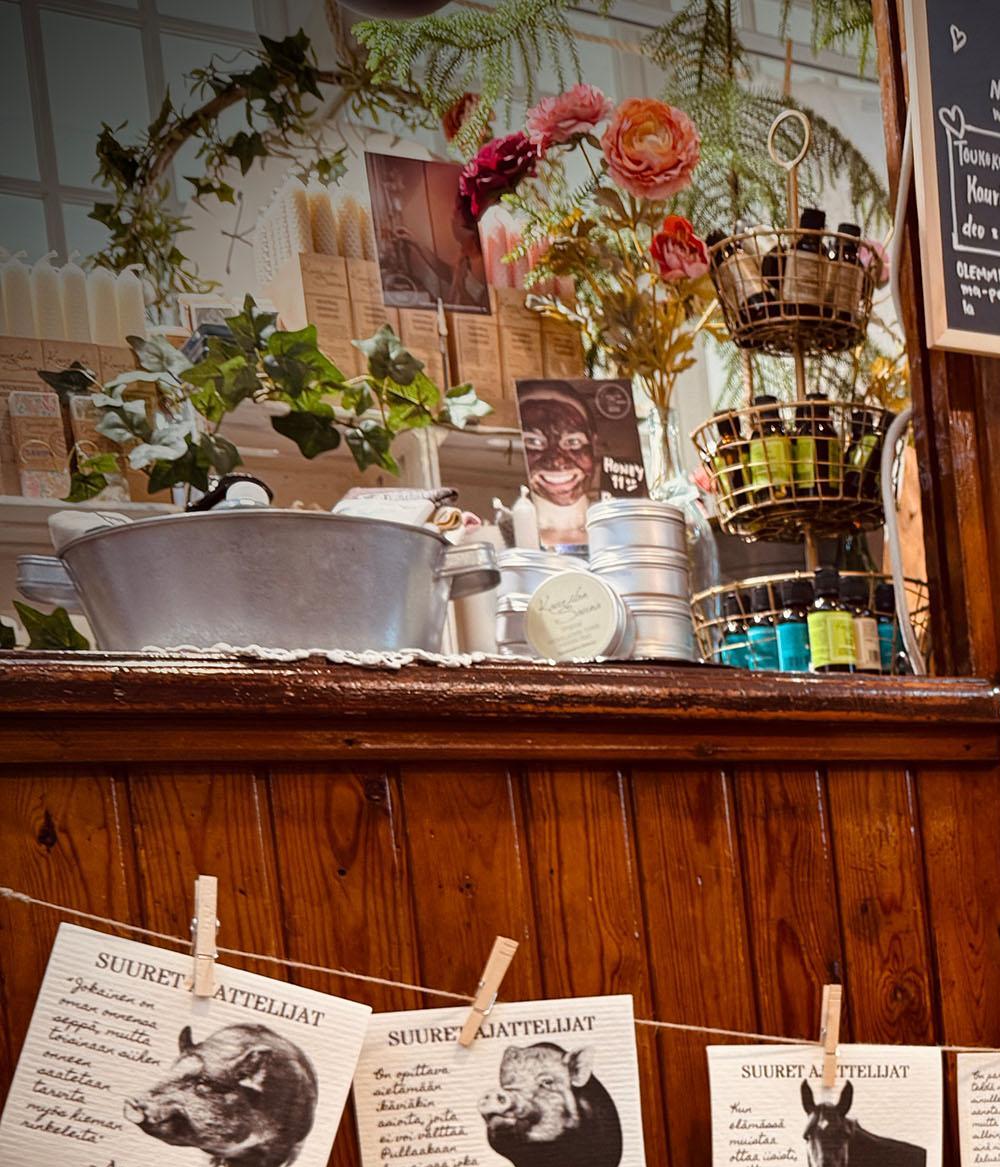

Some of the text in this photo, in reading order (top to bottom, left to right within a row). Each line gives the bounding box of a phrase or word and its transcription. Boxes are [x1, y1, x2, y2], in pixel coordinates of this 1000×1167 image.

[962, 214, 985, 239] deo
[963, 300, 975, 315] la
[96, 951, 325, 1027] SUURET ATTELIJAT
[59, 998, 158, 1030] oman onnensa
[139, 1001, 155, 1010] on
[106, 1029, 153, 1047] mutta
[473, 1016, 596, 1041] AJATTELIJAT
[48, 1026, 161, 1066] toisinaan siihen
[42, 1051, 91, 1067] onneen
[36, 1068, 111, 1091] saatetaan
[741, 1064, 806, 1079] SUURET
[32, 1079, 87, 1104] tarvita
[26, 1102, 123, 1131] myös hieman
[425, 1108, 459, 1131] joita
[729, 1118, 786, 1130] elämässä
[729, 1133, 778, 1146] muistaa
[381, 1143, 457, 1160] Pullaakaan
[729, 1148, 760, 1162] ottaa
